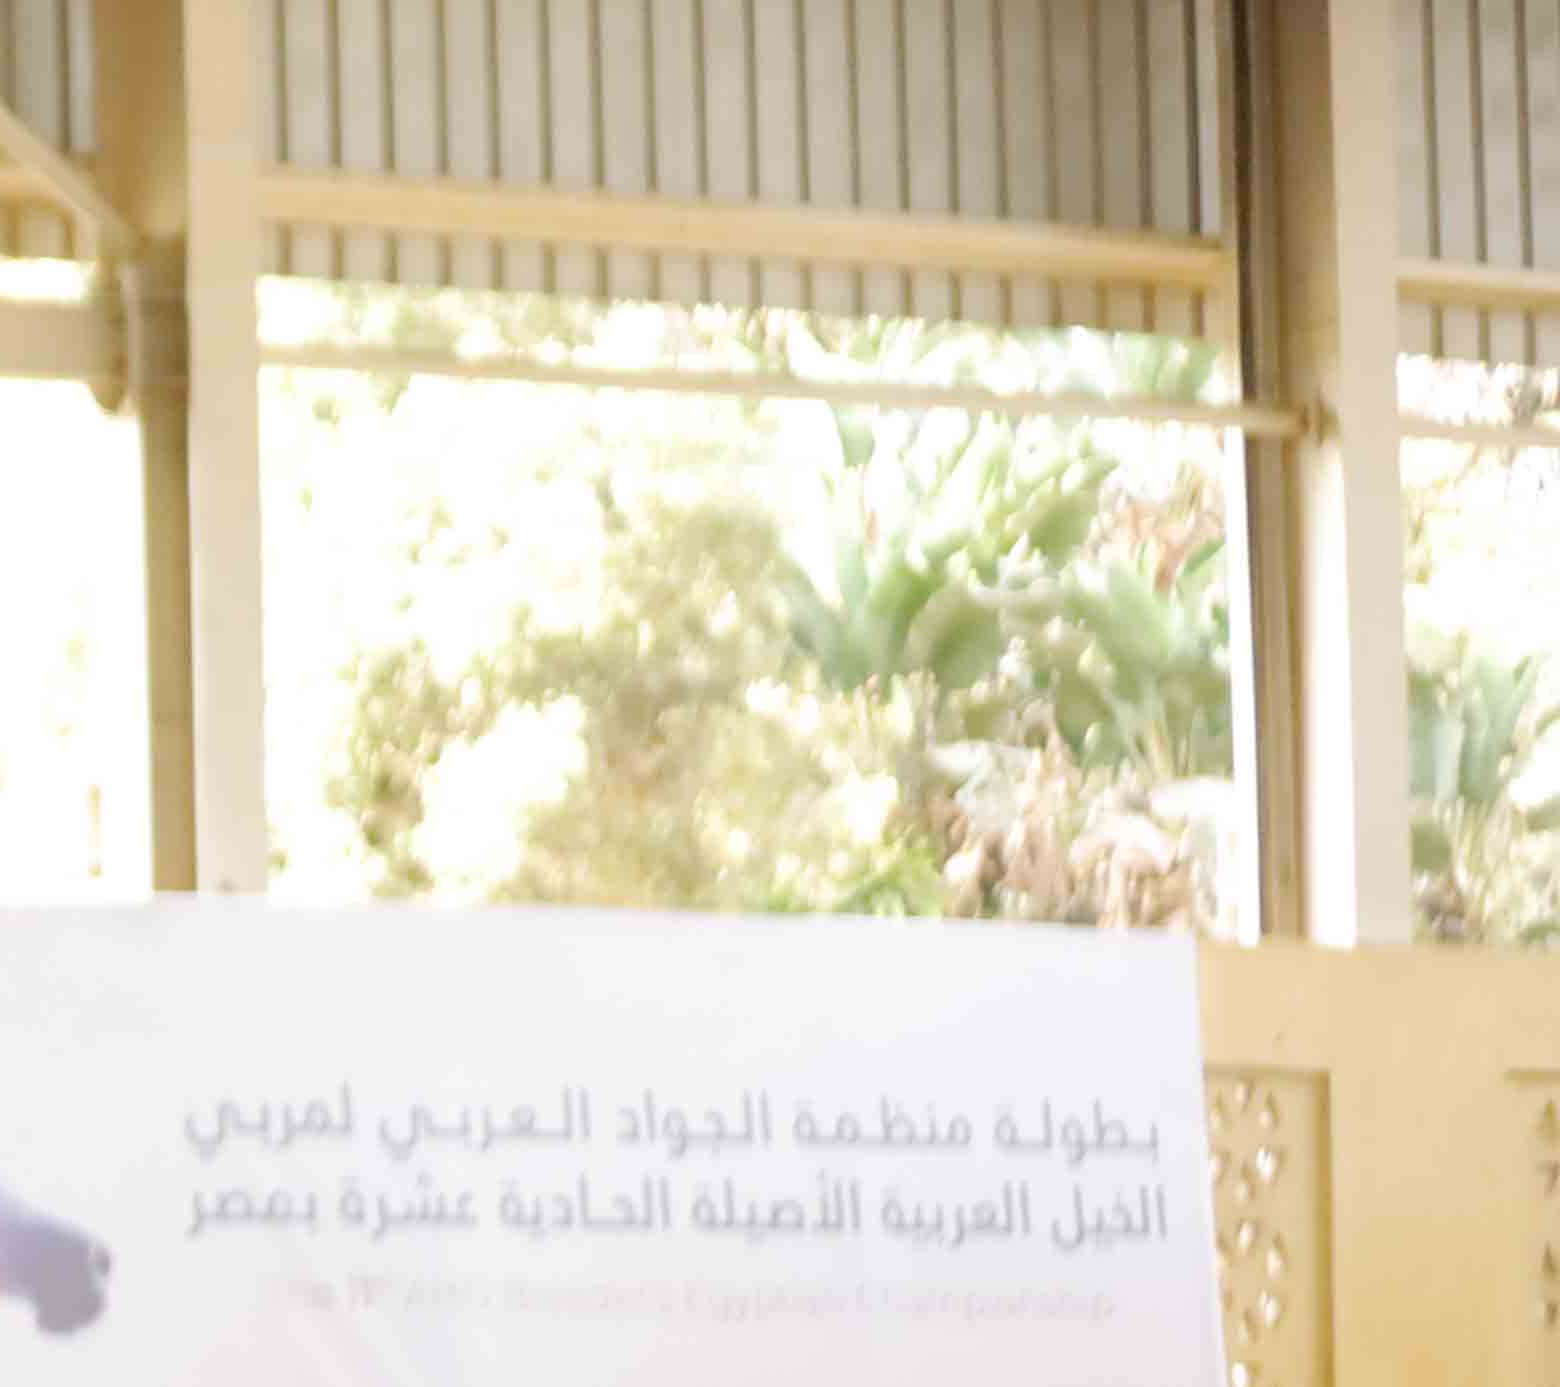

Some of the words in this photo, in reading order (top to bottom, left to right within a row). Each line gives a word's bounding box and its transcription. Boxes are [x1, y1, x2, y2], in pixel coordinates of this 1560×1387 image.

[184, 1077, 352, 1159] لمربي
[377, 1081, 591, 1160] العربي
[617, 1087, 773, 1161] الجواد
[793, 1091, 973, 1150] منظمة
[994, 1096, 1159, 1168] بطولة
[186, 1187, 317, 1241] بمصر
[338, 1171, 478, 1241] عشرة
[499, 1172, 671, 1241] الحادية
[691, 1168, 862, 1243] الأصيلة
[881, 1178, 1031, 1249] العربية
[1052, 1180, 1168, 1252] الخيل
